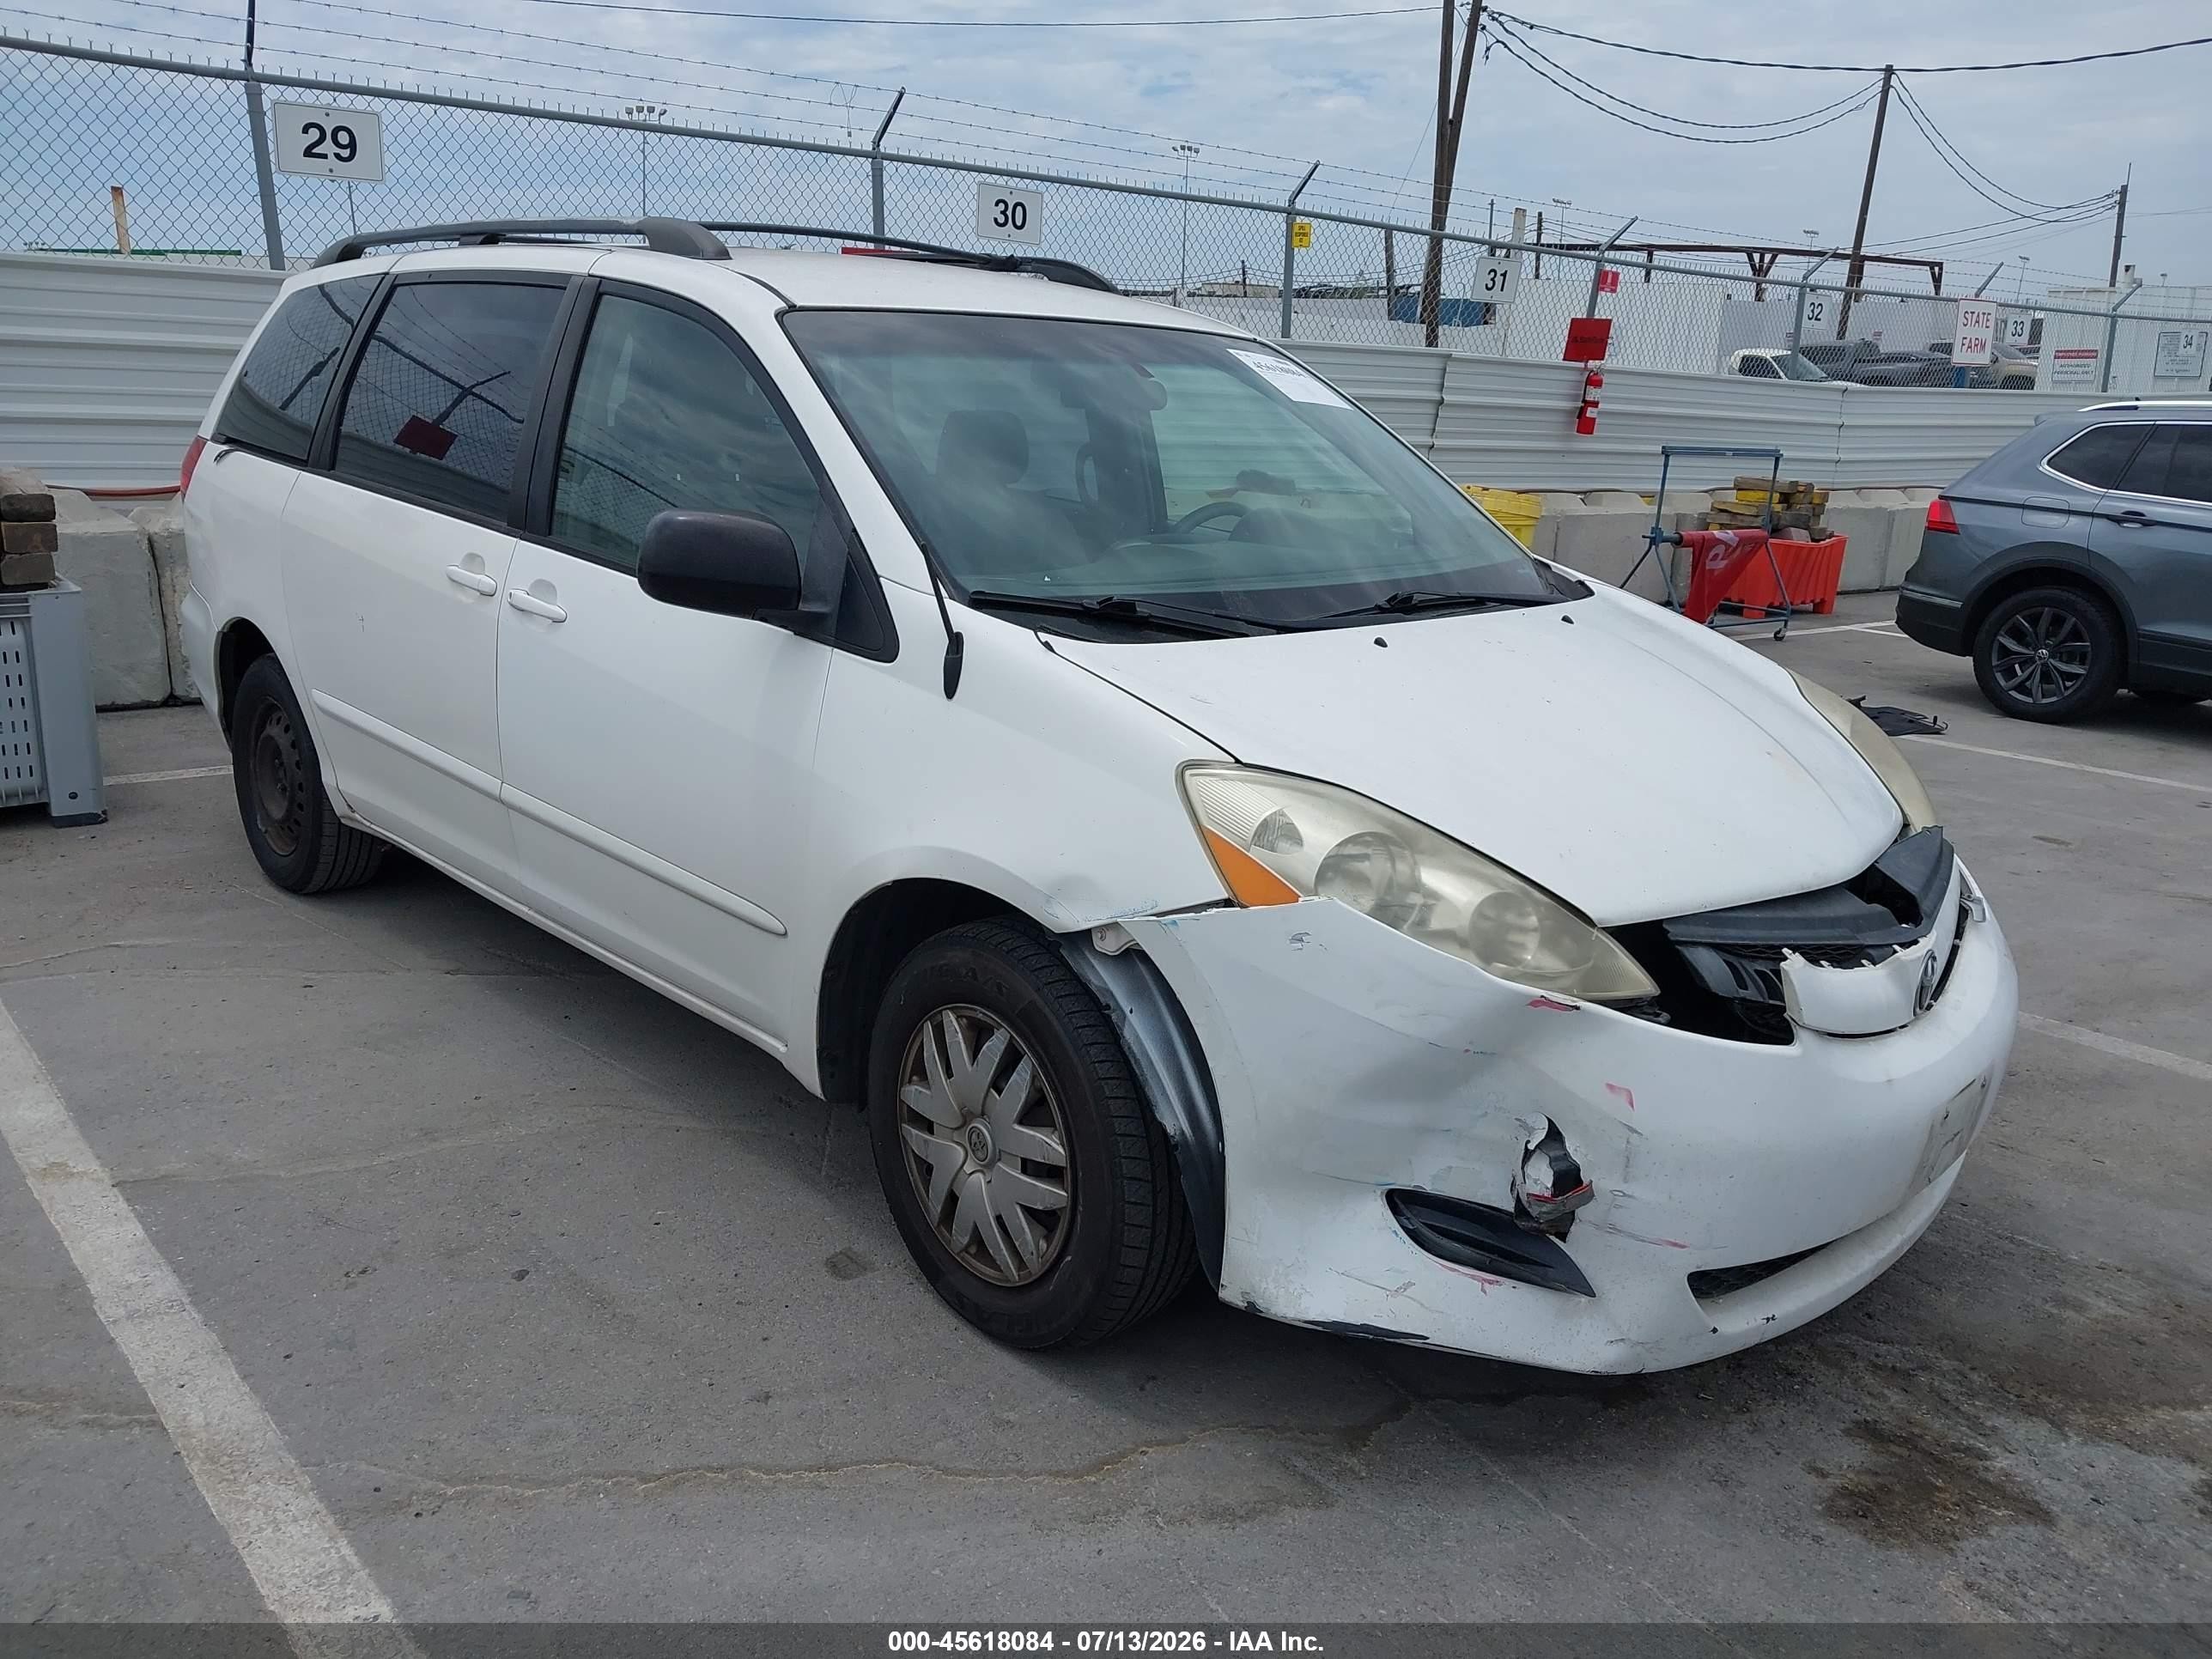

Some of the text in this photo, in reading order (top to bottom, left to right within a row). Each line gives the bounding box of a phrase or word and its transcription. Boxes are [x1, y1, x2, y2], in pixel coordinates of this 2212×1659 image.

[301, 121, 357, 163] 29
[993, 198, 1027, 231] 30
[1485, 268, 1509, 292] 31
[1807, 301, 1824, 322] 32
[1962, 310, 1992, 329] STATE
[2011, 320, 2025, 337] 33
[1960, 336, 1987, 355] FARM
[2183, 334, 2193, 349] 34
